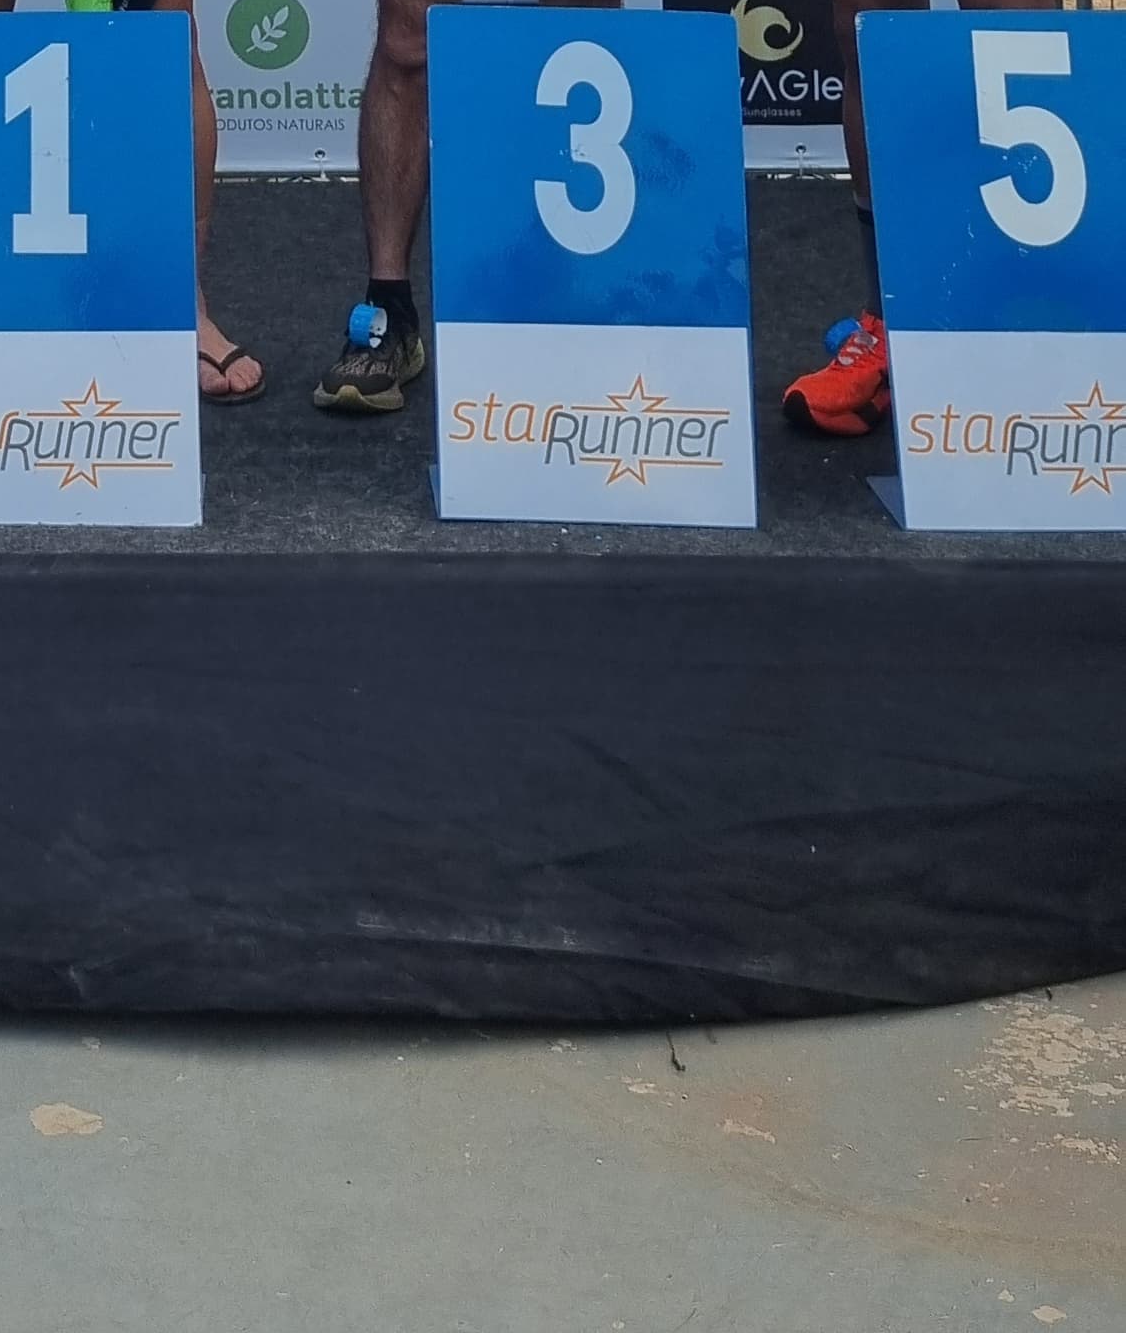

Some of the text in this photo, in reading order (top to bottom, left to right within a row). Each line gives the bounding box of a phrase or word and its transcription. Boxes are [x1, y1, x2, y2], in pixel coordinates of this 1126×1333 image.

[5, 43, 88, 254] 1
[209, 82, 364, 109] anolatta
[277, 118, 345, 131] NATURAIS
[534, 41, 636, 254] 3
[971, 30, 1087, 246] 5
